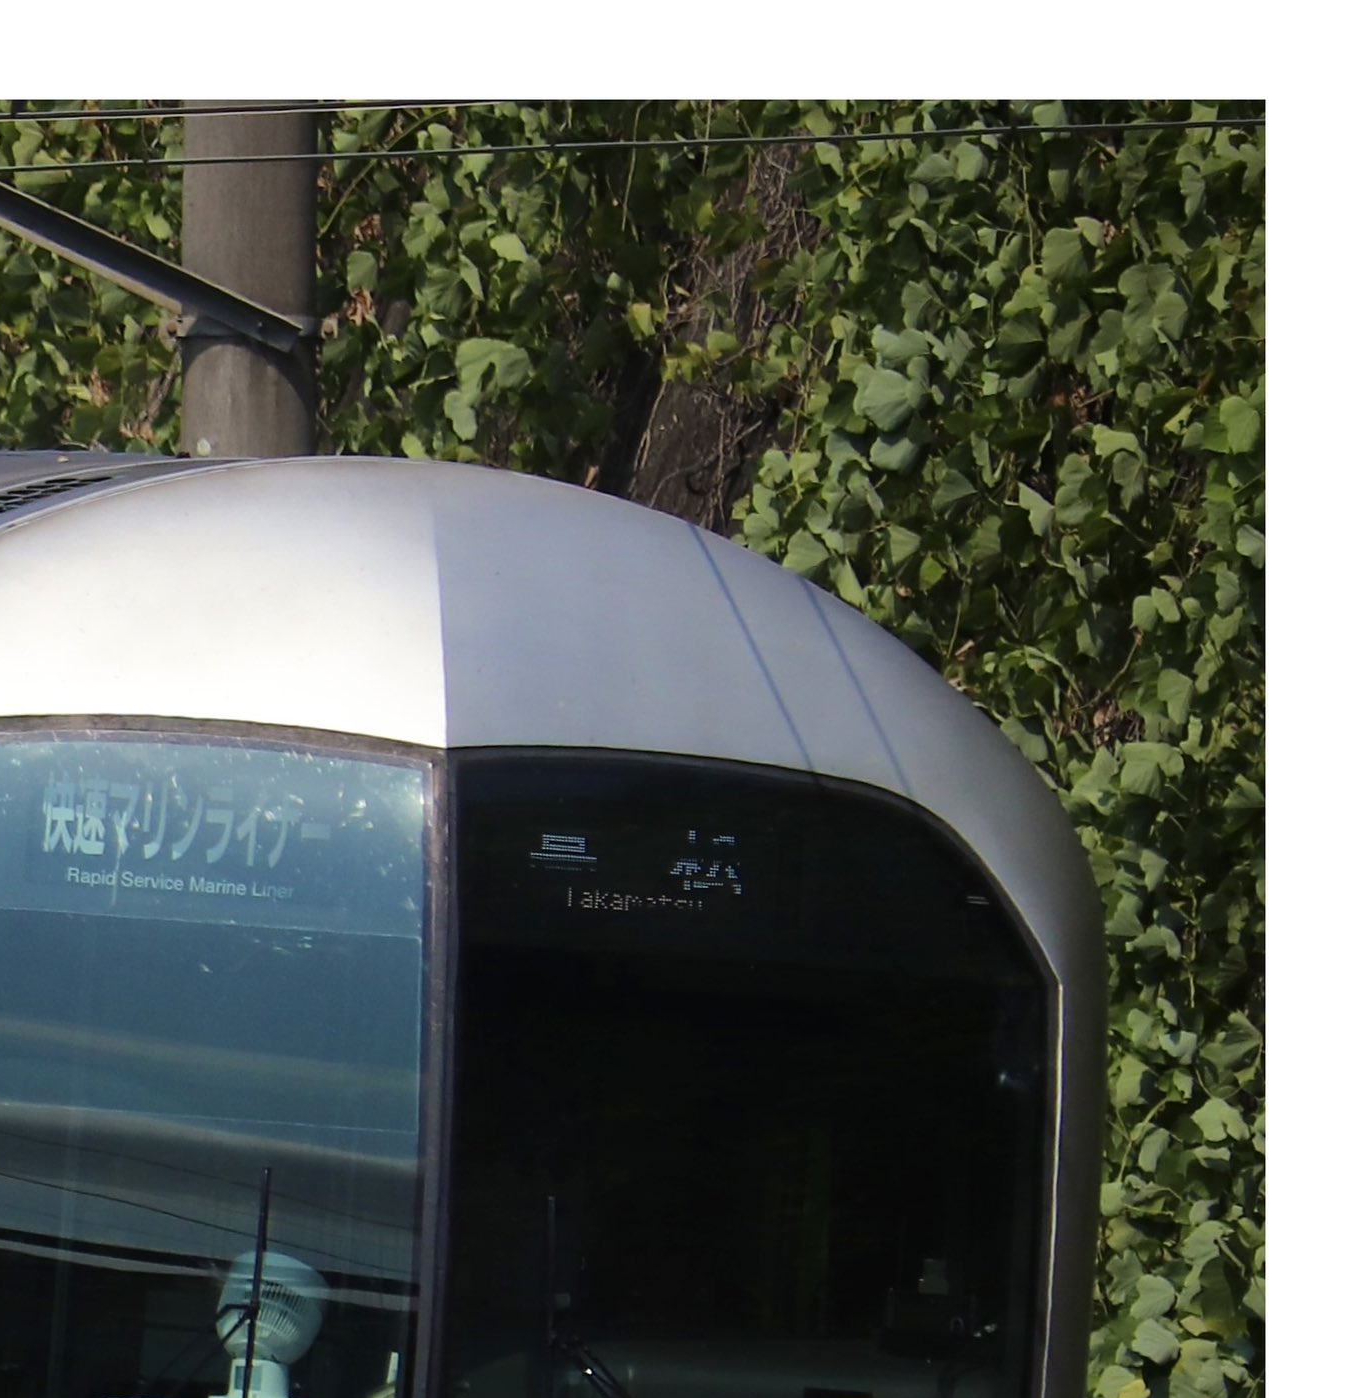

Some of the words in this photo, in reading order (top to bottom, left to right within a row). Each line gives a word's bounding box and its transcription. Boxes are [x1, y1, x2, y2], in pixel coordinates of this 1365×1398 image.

[42, 772, 332, 868] 快速マリンライナー
[66, 866, 116, 887] Rapid
[120, 871, 184, 892] Service
[189, 876, 247, 896] Marine
[251, 881, 295, 900] Liner
